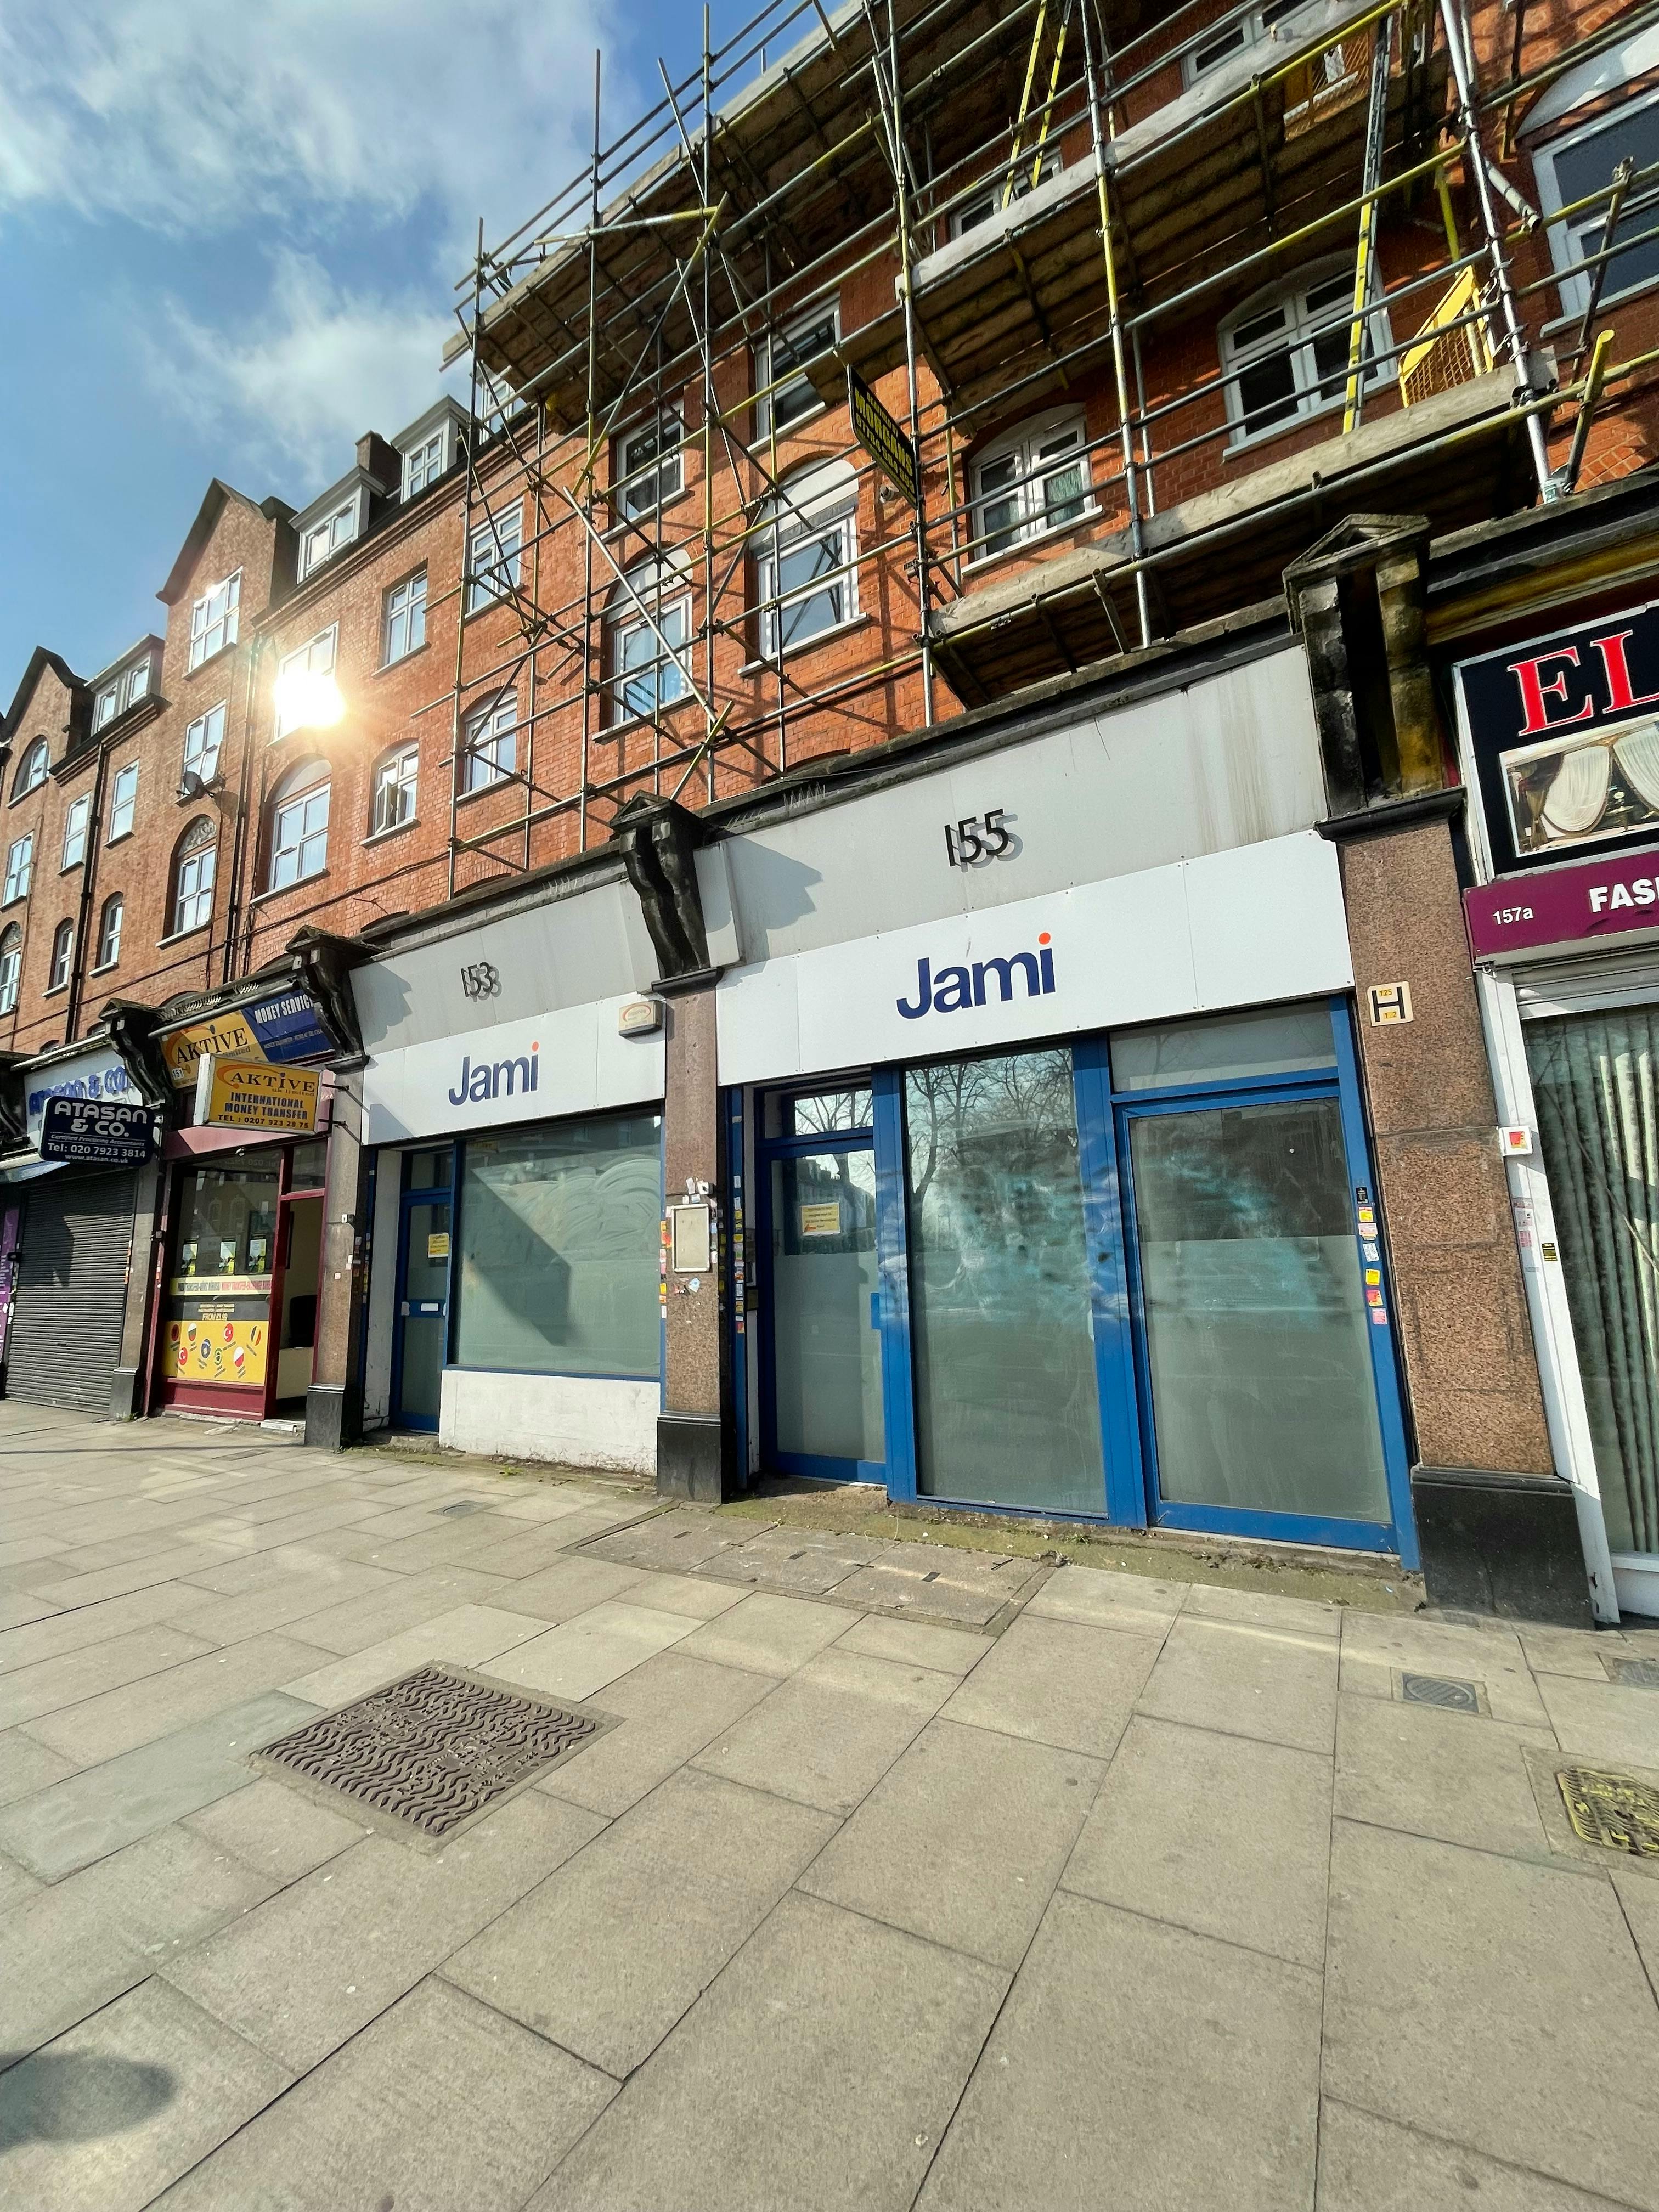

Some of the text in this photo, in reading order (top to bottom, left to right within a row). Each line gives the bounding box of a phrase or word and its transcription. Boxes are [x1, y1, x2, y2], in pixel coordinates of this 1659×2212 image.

[855, 387, 913, 476] MORGANS
[944, 809, 1009, 866] 155
[1493, 877, 1659, 925] 157a FAS
[461, 962, 494, 997] 153
[896, 932, 1056, 1019] Jami
[255, 994, 314, 1024] MONEY SERVIC
[173, 1069, 183, 1079] 151
[448, 1041, 539, 1106] Jami
[55, 1101, 148, 1124] ATASAN
[225, 1103, 308, 1120] MONEY TRANSFER
[230, 1092, 303, 1108] INTERNATIONAL
[71, 1119, 129, 1137] & CO.
[48, 1143, 146, 1158] Tel: 020 7923 3814
[65, 1154, 129, 1164] www.atasan.co.uk
